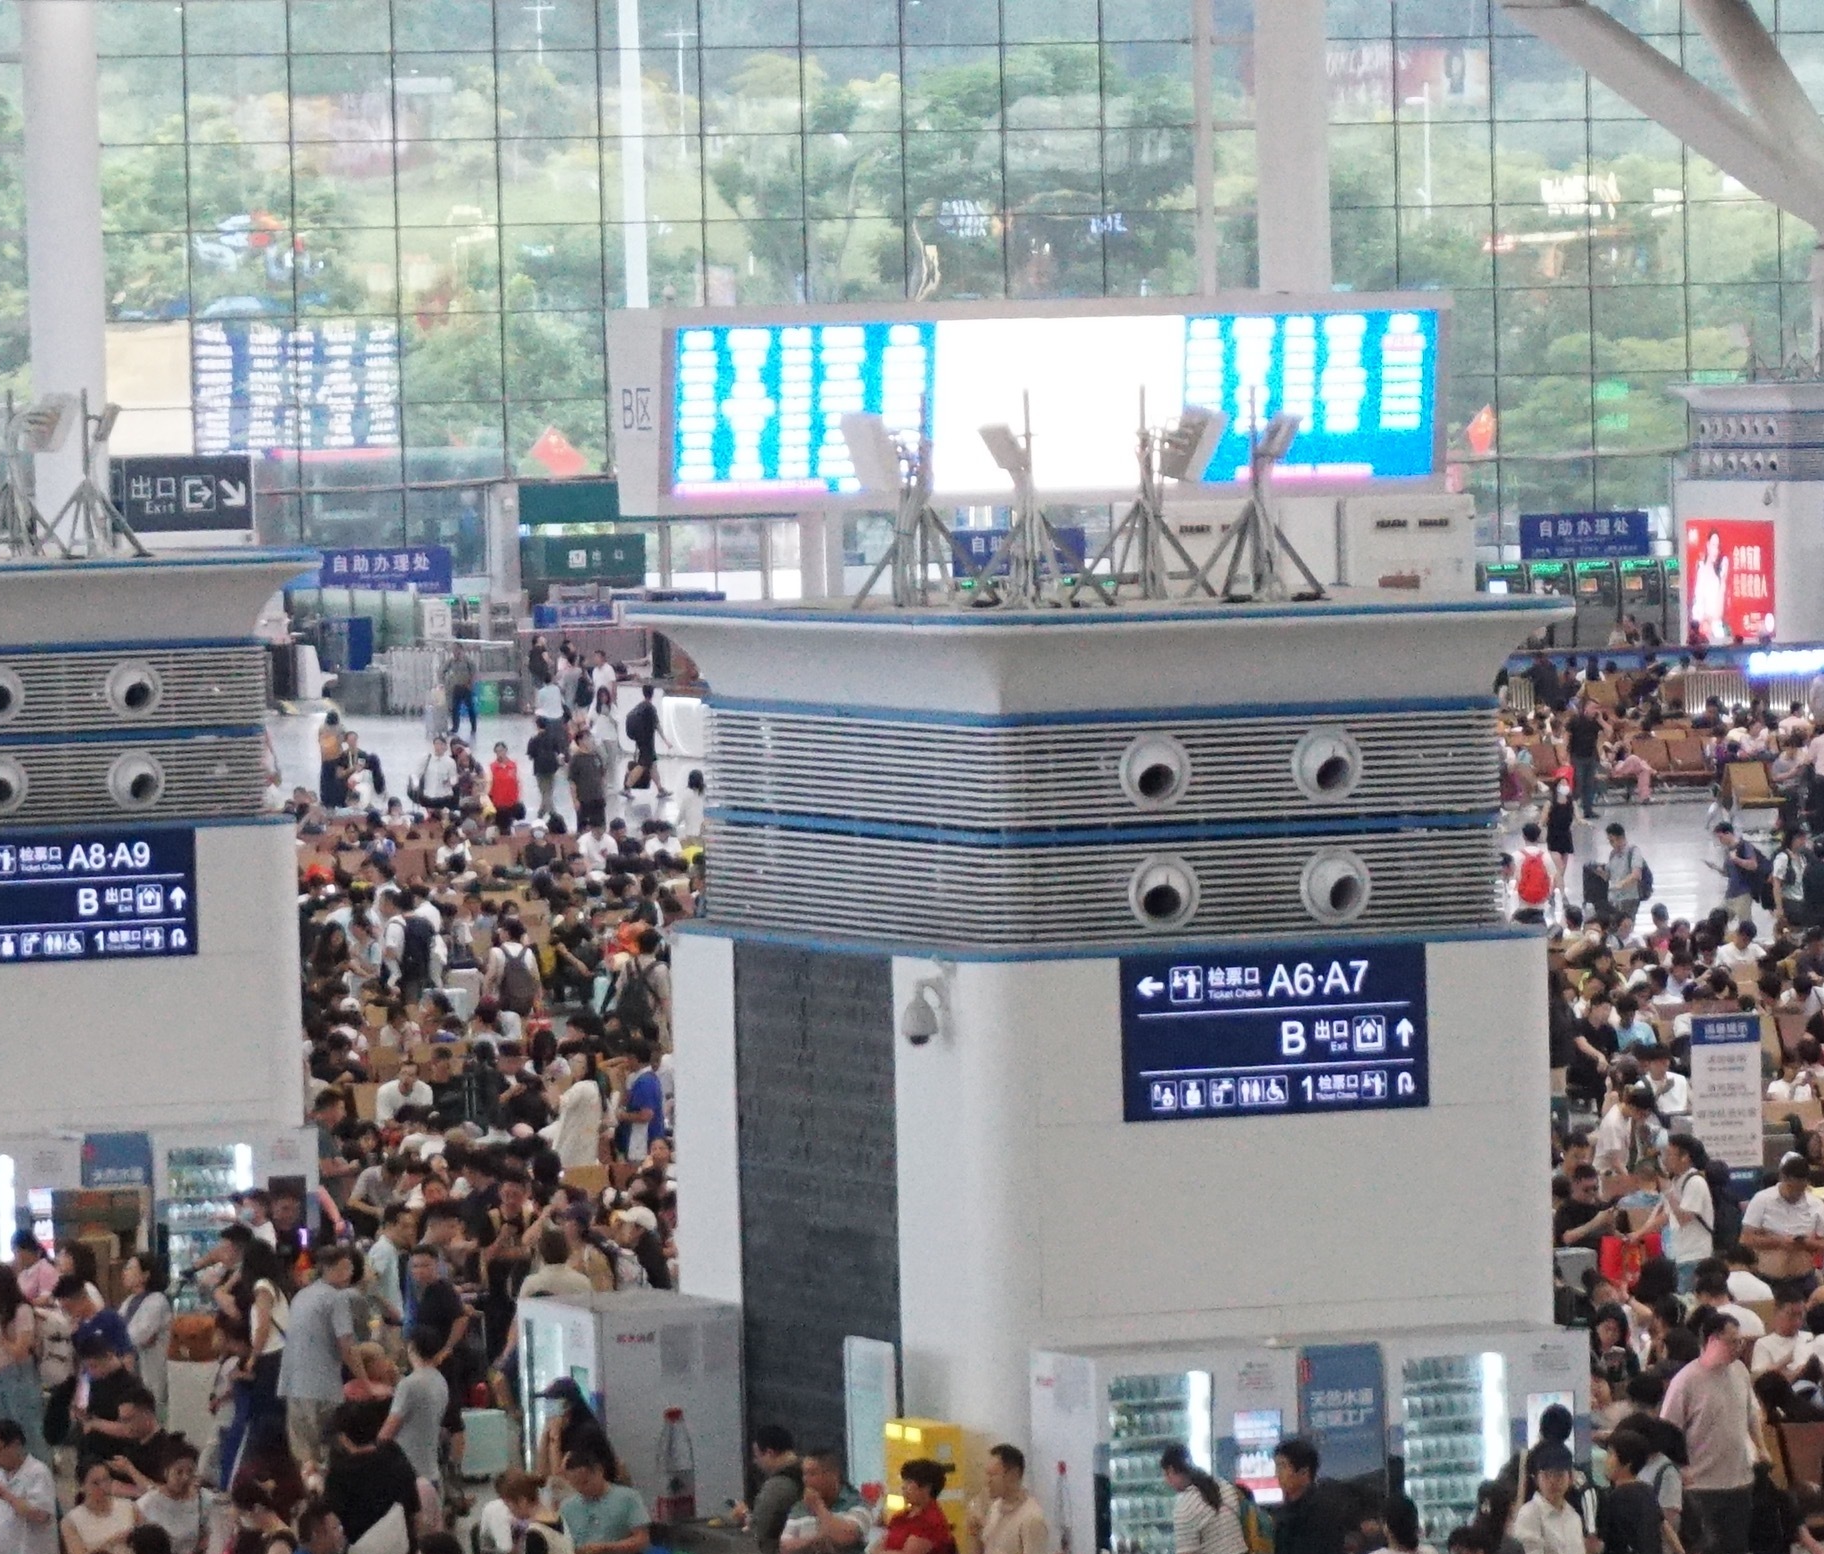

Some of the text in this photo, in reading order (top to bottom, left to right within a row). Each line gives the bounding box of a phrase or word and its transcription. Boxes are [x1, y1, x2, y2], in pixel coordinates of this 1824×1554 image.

[622, 387, 653, 431] B区
[131, 475, 175, 499] 出口
[146, 501, 175, 514] Exit
[1539, 517, 1629, 538] 自助办理处
[333, 552, 430, 573] 自助办理处
[19, 841, 150, 870] 检票口 A8·A9
[78, 887, 133, 915] B 出口
[94, 929, 141, 951] 1 检票口
[1208, 960, 1369, 997] 检票口 A6·A7
[1208, 988, 1262, 1000] Ticket Check
[1281, 1019, 1348, 1055] B 出口
[1331, 1041, 1348, 1050] Exit
[1302, 1074, 1359, 1103] 1 检票口
